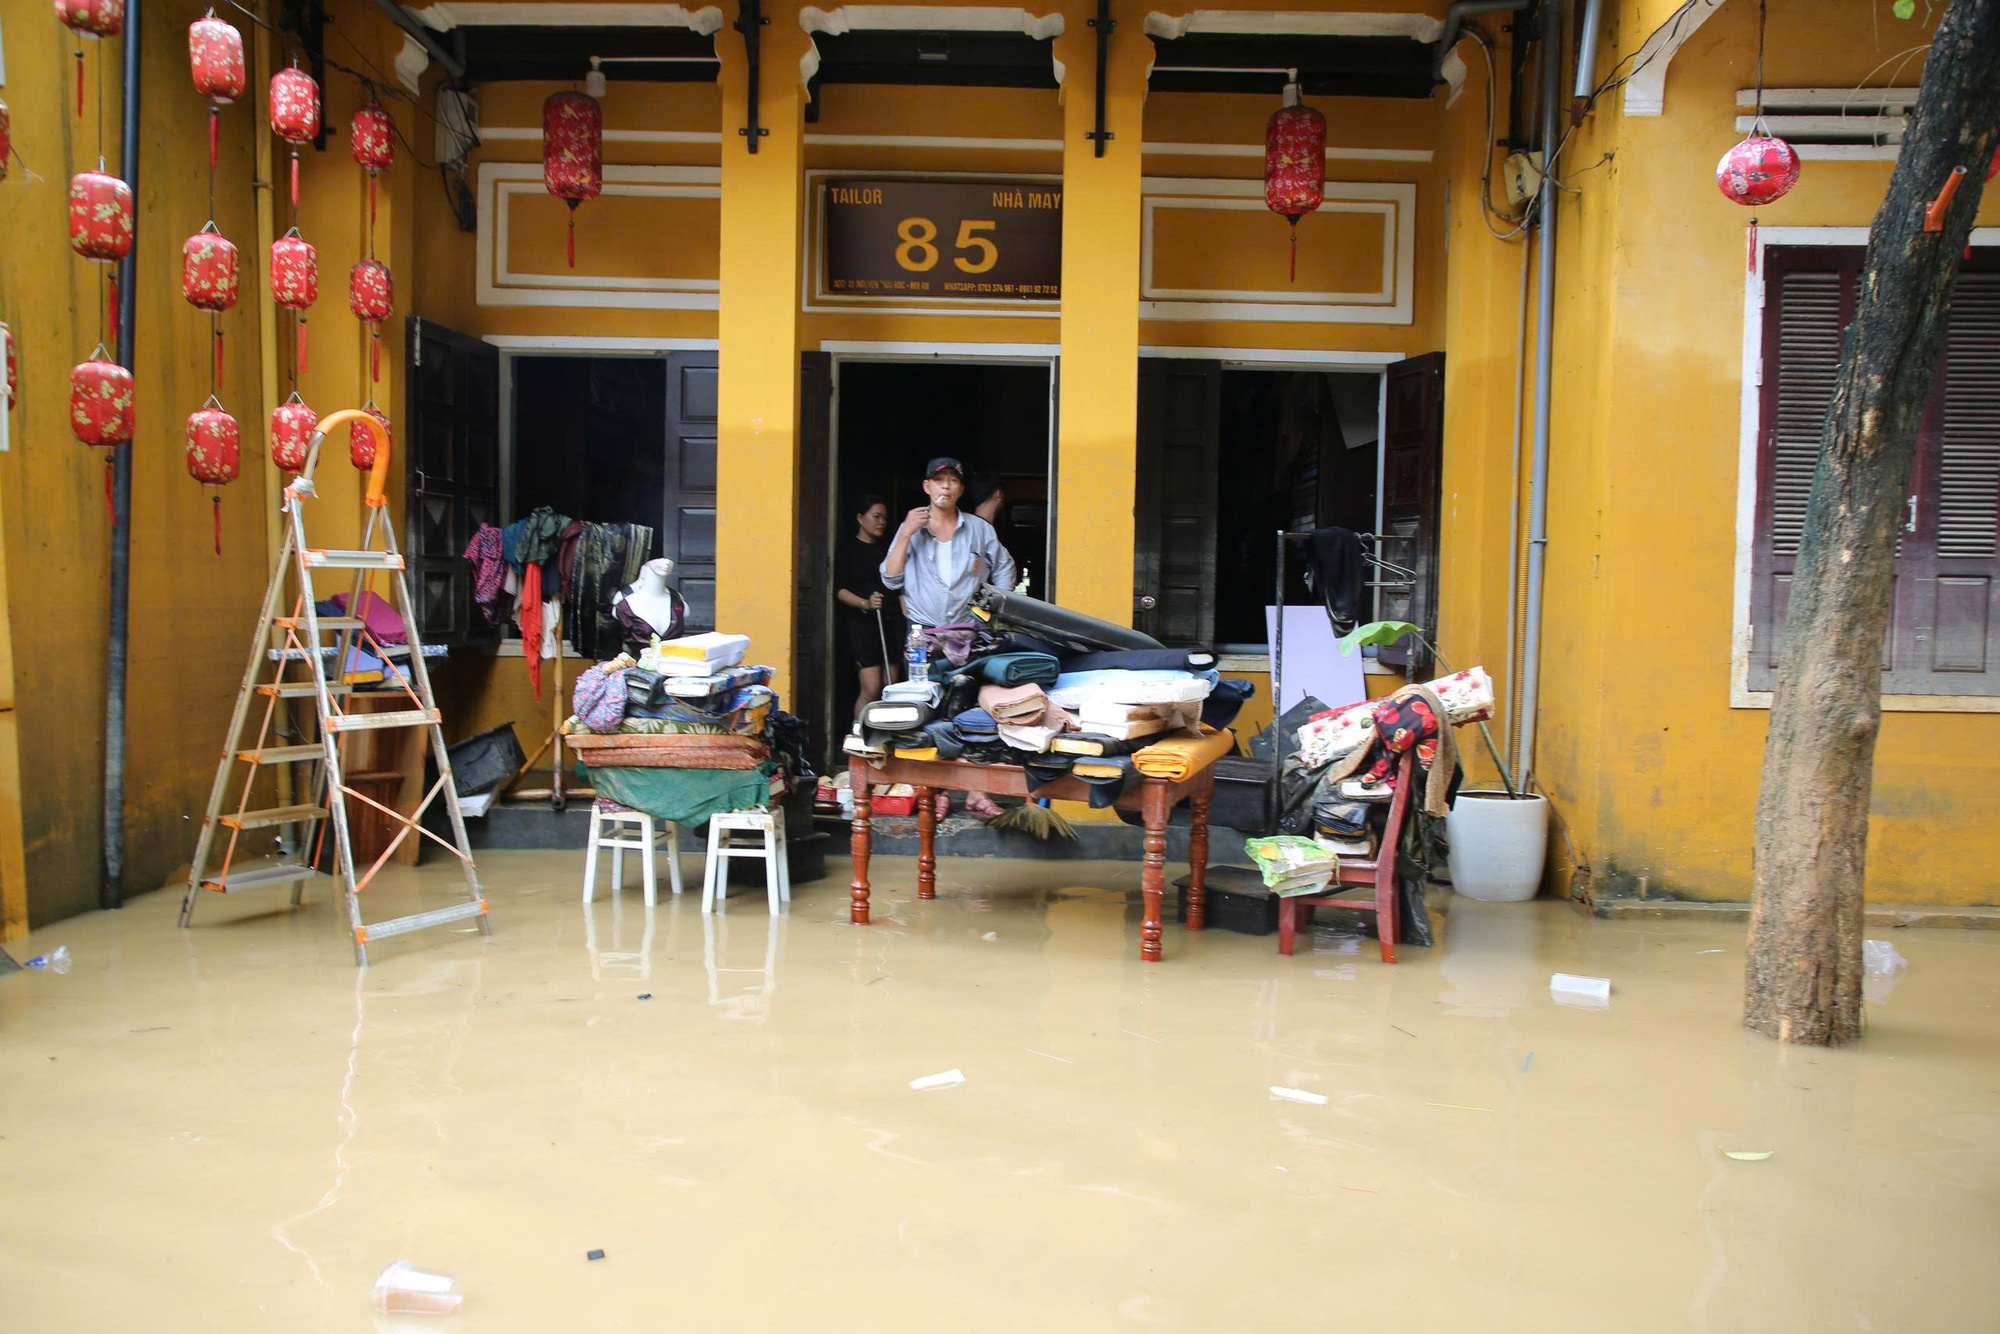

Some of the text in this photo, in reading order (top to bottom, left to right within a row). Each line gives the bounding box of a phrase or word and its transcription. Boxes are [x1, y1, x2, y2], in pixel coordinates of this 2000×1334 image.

[831, 187, 883, 205] TAILOR
[992, 188, 1062, 209] NHÀ MAY
[895, 217, 999, 274] 85
